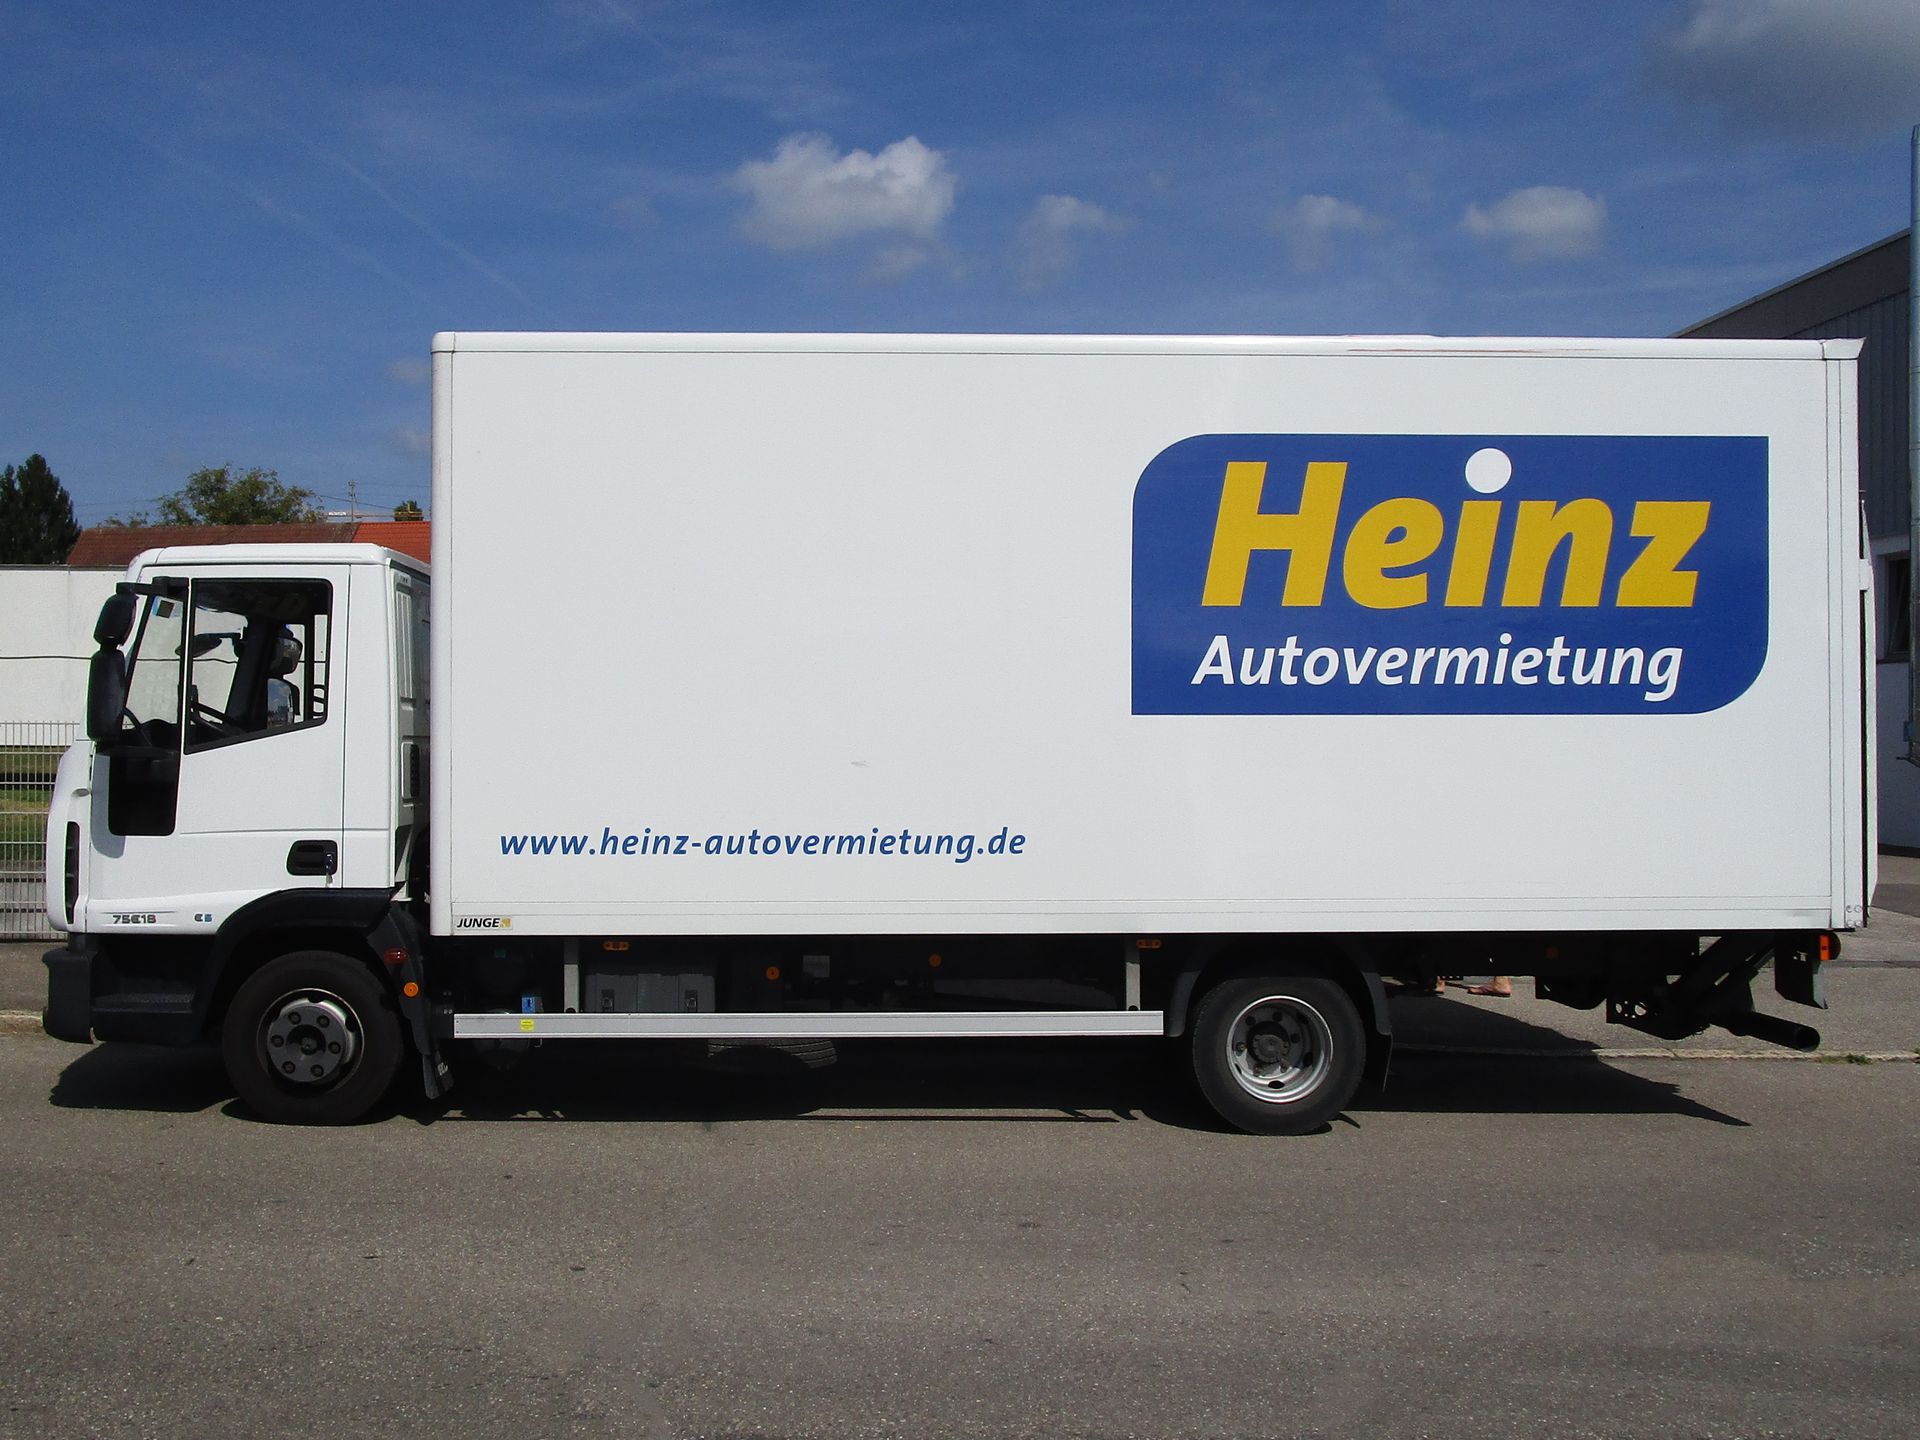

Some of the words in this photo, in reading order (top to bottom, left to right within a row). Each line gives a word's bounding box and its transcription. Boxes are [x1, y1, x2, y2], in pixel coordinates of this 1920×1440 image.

[1202, 448, 1711, 609] Heinz
[1191, 633, 1683, 702] Autovermietung
[501, 827, 1026, 864] www.heinz-autovermietung.de
[456, 917, 501, 928] JUNGE
